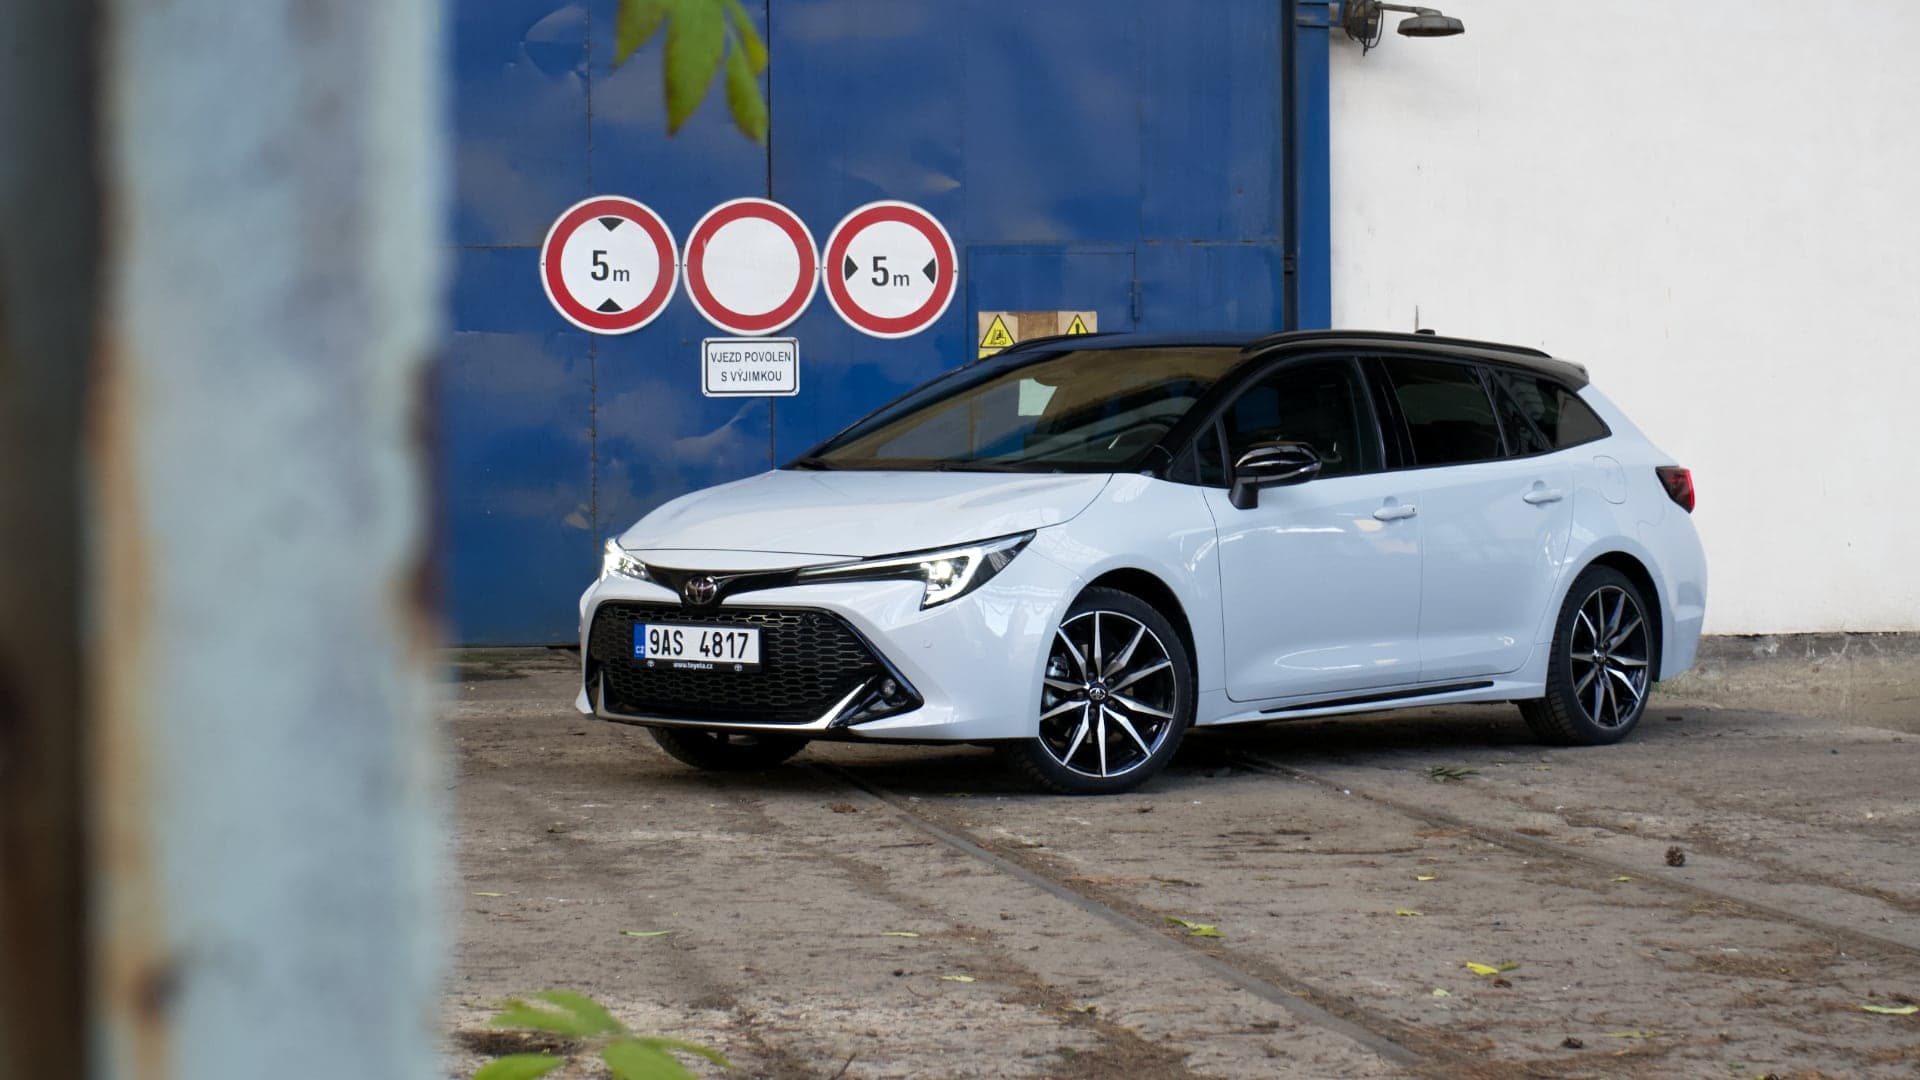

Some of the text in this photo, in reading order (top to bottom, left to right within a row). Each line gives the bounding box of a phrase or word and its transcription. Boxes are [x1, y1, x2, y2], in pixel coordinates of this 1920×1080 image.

[591, 249, 630, 282] 5 m
[871, 255, 910, 287] 5 m
[710, 351, 791, 363] VJEZD POVOLEN
[721, 369, 782, 382] S VÝJIMKOU
[635, 645, 645, 655] CZ
[649, 628, 750, 659] 9AS 4817
[672, 661, 714, 670] www.toyota.cz
